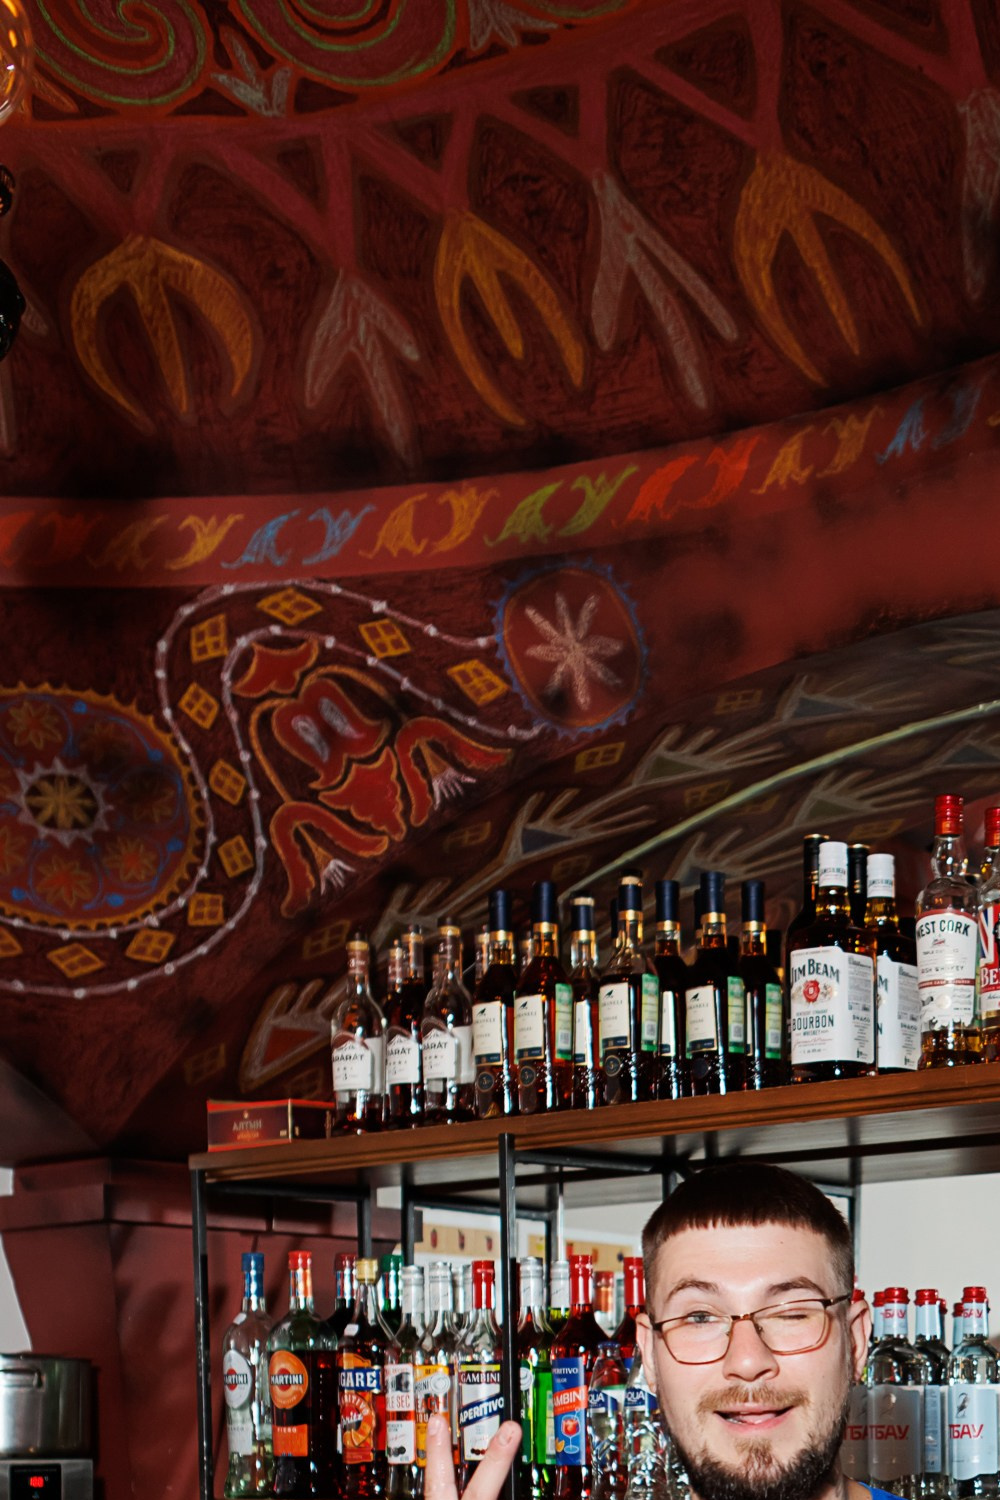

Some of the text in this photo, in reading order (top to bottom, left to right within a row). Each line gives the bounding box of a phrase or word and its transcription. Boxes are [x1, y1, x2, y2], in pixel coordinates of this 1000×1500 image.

[939, 919, 971, 936] CORK
[807, 958, 840, 984] BEAM
[793, 1015, 834, 1031] BOURBON
[270, 1374, 303, 1385] MARTINI
[461, 1372, 500, 1383] GAMBINI
[396, 1395, 410, 1408] SEC
[459, 1397, 505, 1424] APERITIVO
